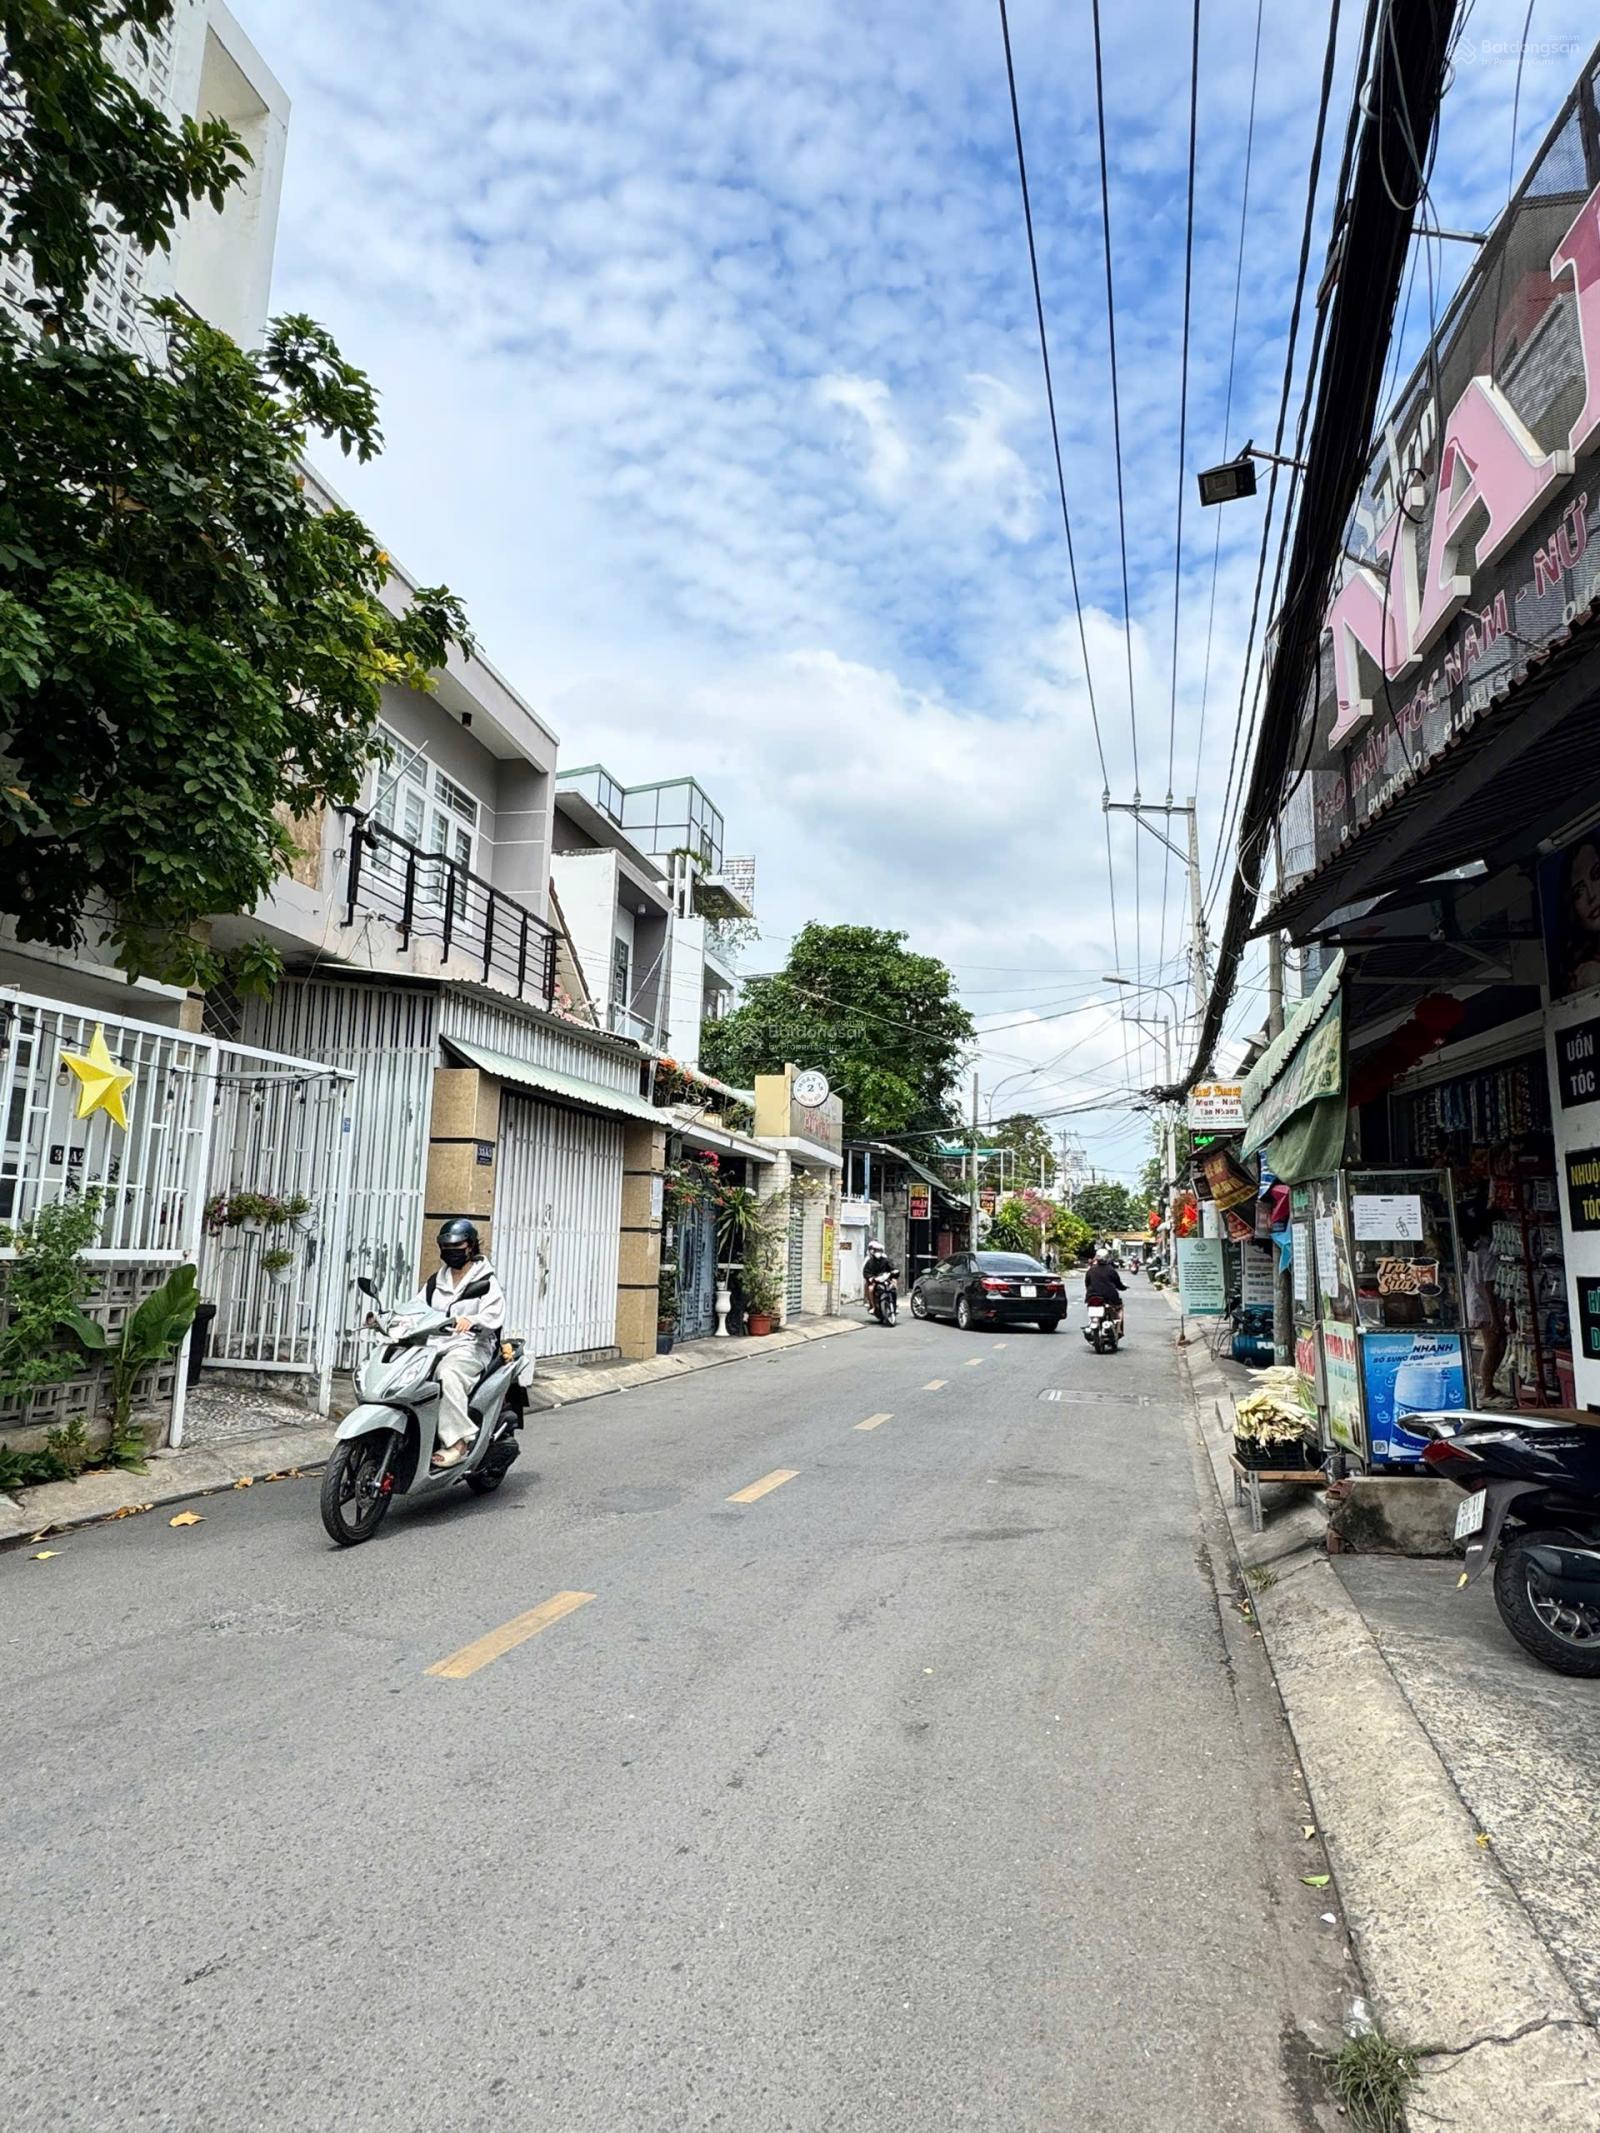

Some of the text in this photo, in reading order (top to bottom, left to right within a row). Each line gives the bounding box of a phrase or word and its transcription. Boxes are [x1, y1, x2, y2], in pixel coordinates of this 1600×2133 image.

[1443, 589, 1509, 697] NAM
[1533, 491, 1588, 600] NỮ
[1566, 1030, 1593, 1061] UỐN
[807, 1084, 815, 1092] 2
[1570, 1069, 1595, 1096] TÓC
[1571, 1158, 1600, 1188] NHUỘ
[1413, 1344, 1454, 1353] NHANH
